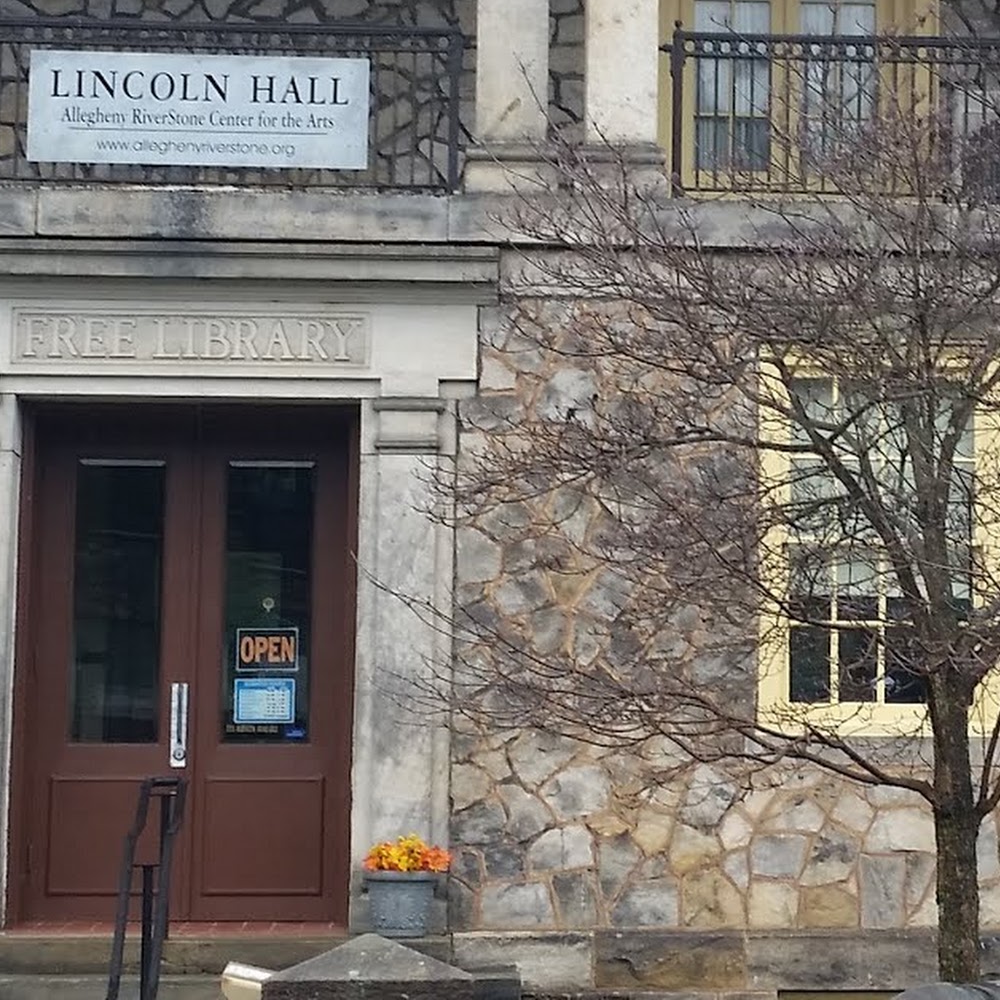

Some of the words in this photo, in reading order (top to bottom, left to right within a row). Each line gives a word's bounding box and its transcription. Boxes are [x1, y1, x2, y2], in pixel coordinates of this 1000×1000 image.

[50, 69, 230, 103] LINCOLN
[250, 75, 350, 105] HALL
[61, 106, 128, 127] Allegheny
[132, 108, 206, 126] RiverStone
[209, 110, 254, 127] Center
[258, 110, 279, 128] for
[281, 111, 304, 128] the
[306, 113, 335, 129] Arts
[96, 139, 296, 158] www.alleghenyriverstone.org
[18, 316, 137, 358] FREE
[152, 317, 363, 362] LIBRARY
[240, 636, 295, 664] OPEN
